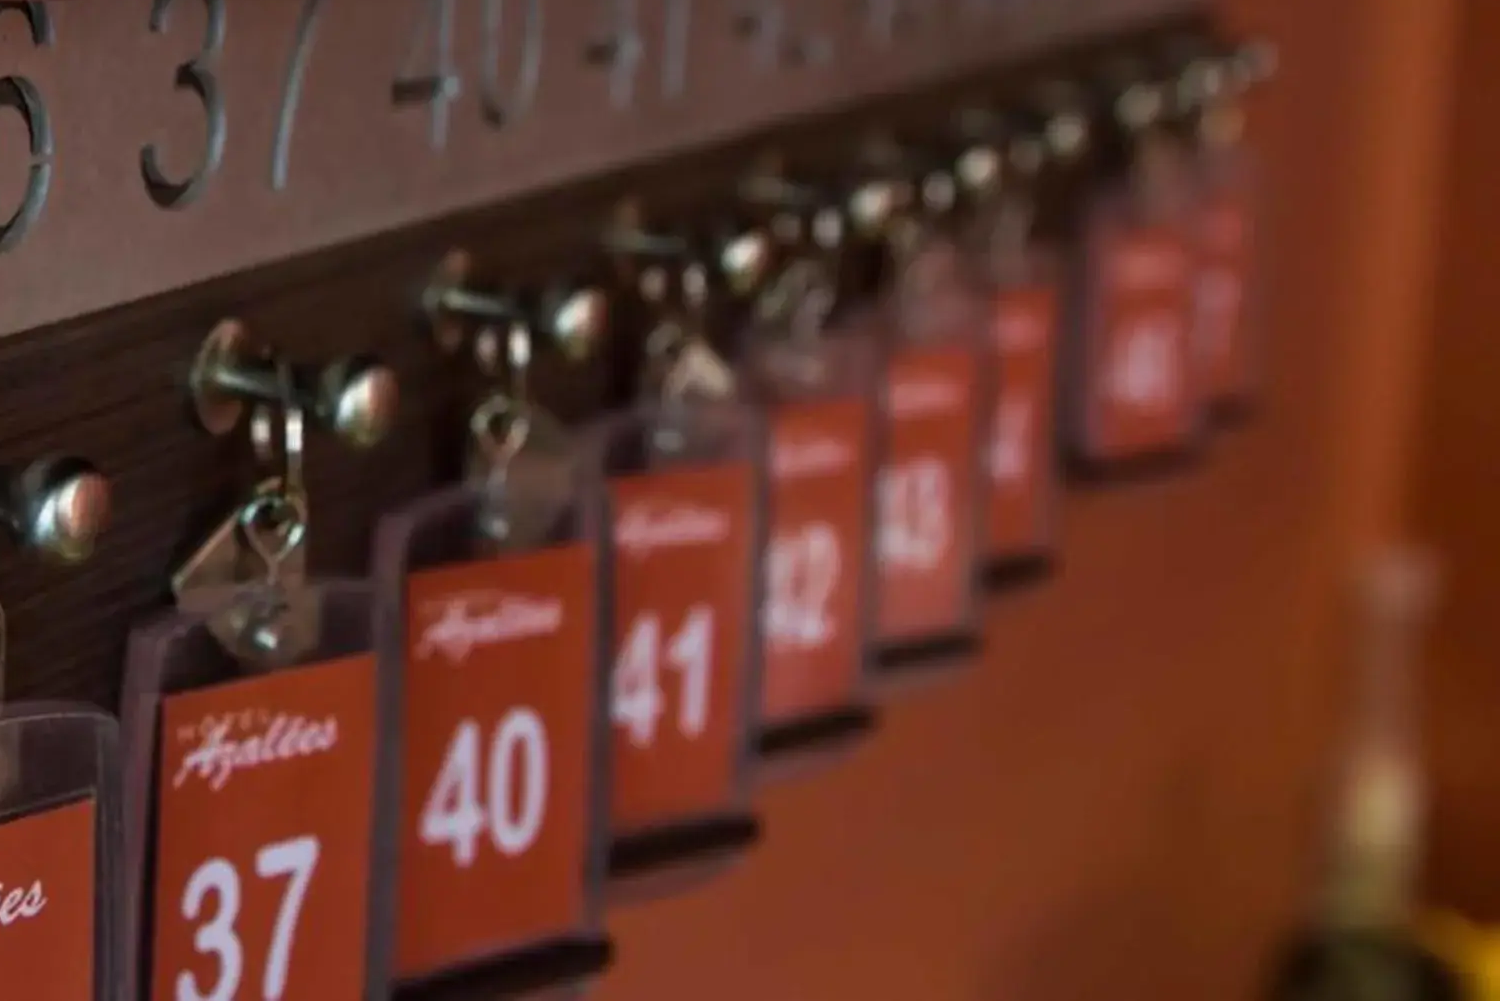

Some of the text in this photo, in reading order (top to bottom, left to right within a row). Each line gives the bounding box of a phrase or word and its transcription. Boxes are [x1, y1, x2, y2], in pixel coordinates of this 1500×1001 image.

[609, 603, 714, 748] 41
[419, 705, 547, 868] 40
[175, 836, 320, 1001] 37
